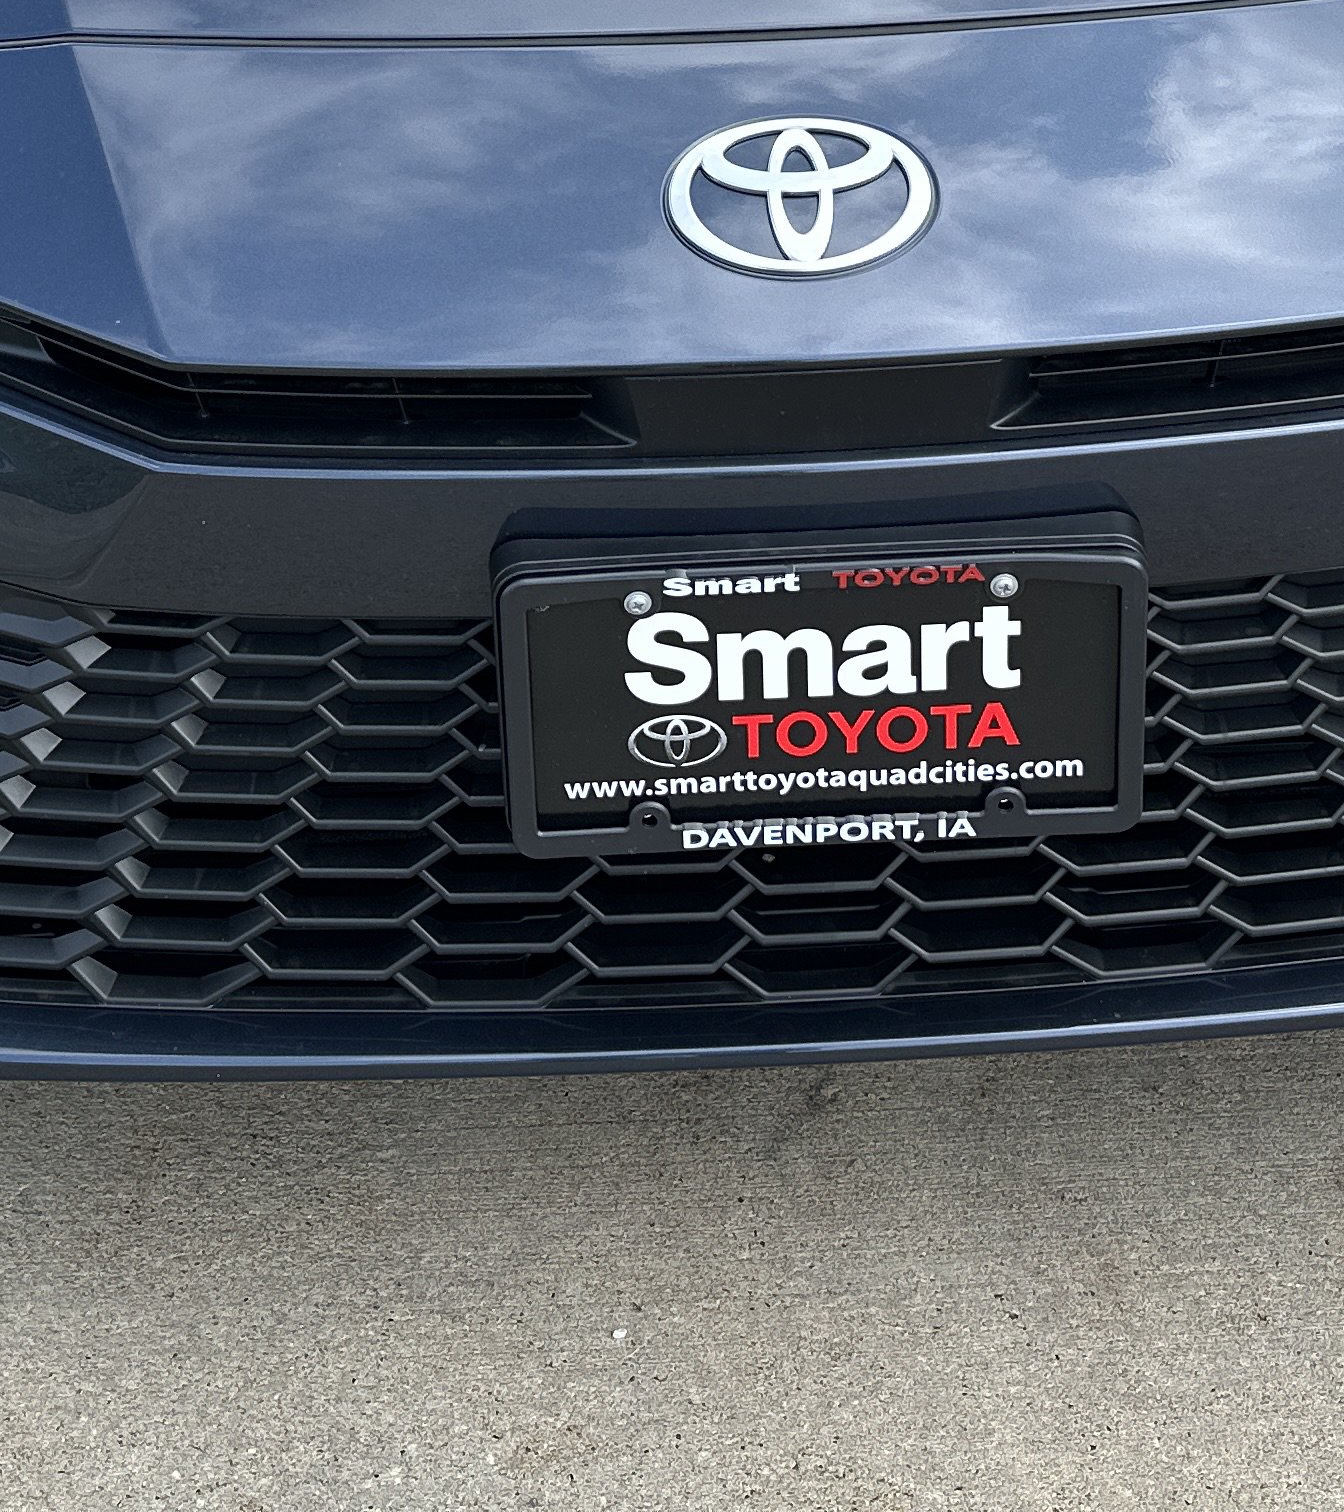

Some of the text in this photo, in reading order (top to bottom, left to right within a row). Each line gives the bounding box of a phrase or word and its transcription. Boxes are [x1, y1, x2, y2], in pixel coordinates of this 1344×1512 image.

[662, 564, 986, 597] Smart TOYOTA
[623, 605, 1021, 705] Smart
[733, 702, 1020, 759] TOYOTA
[565, 758, 1084, 799] www.smarttoyotaquadcities.com
[681, 813, 976, 850] DAVENPORT, IA
